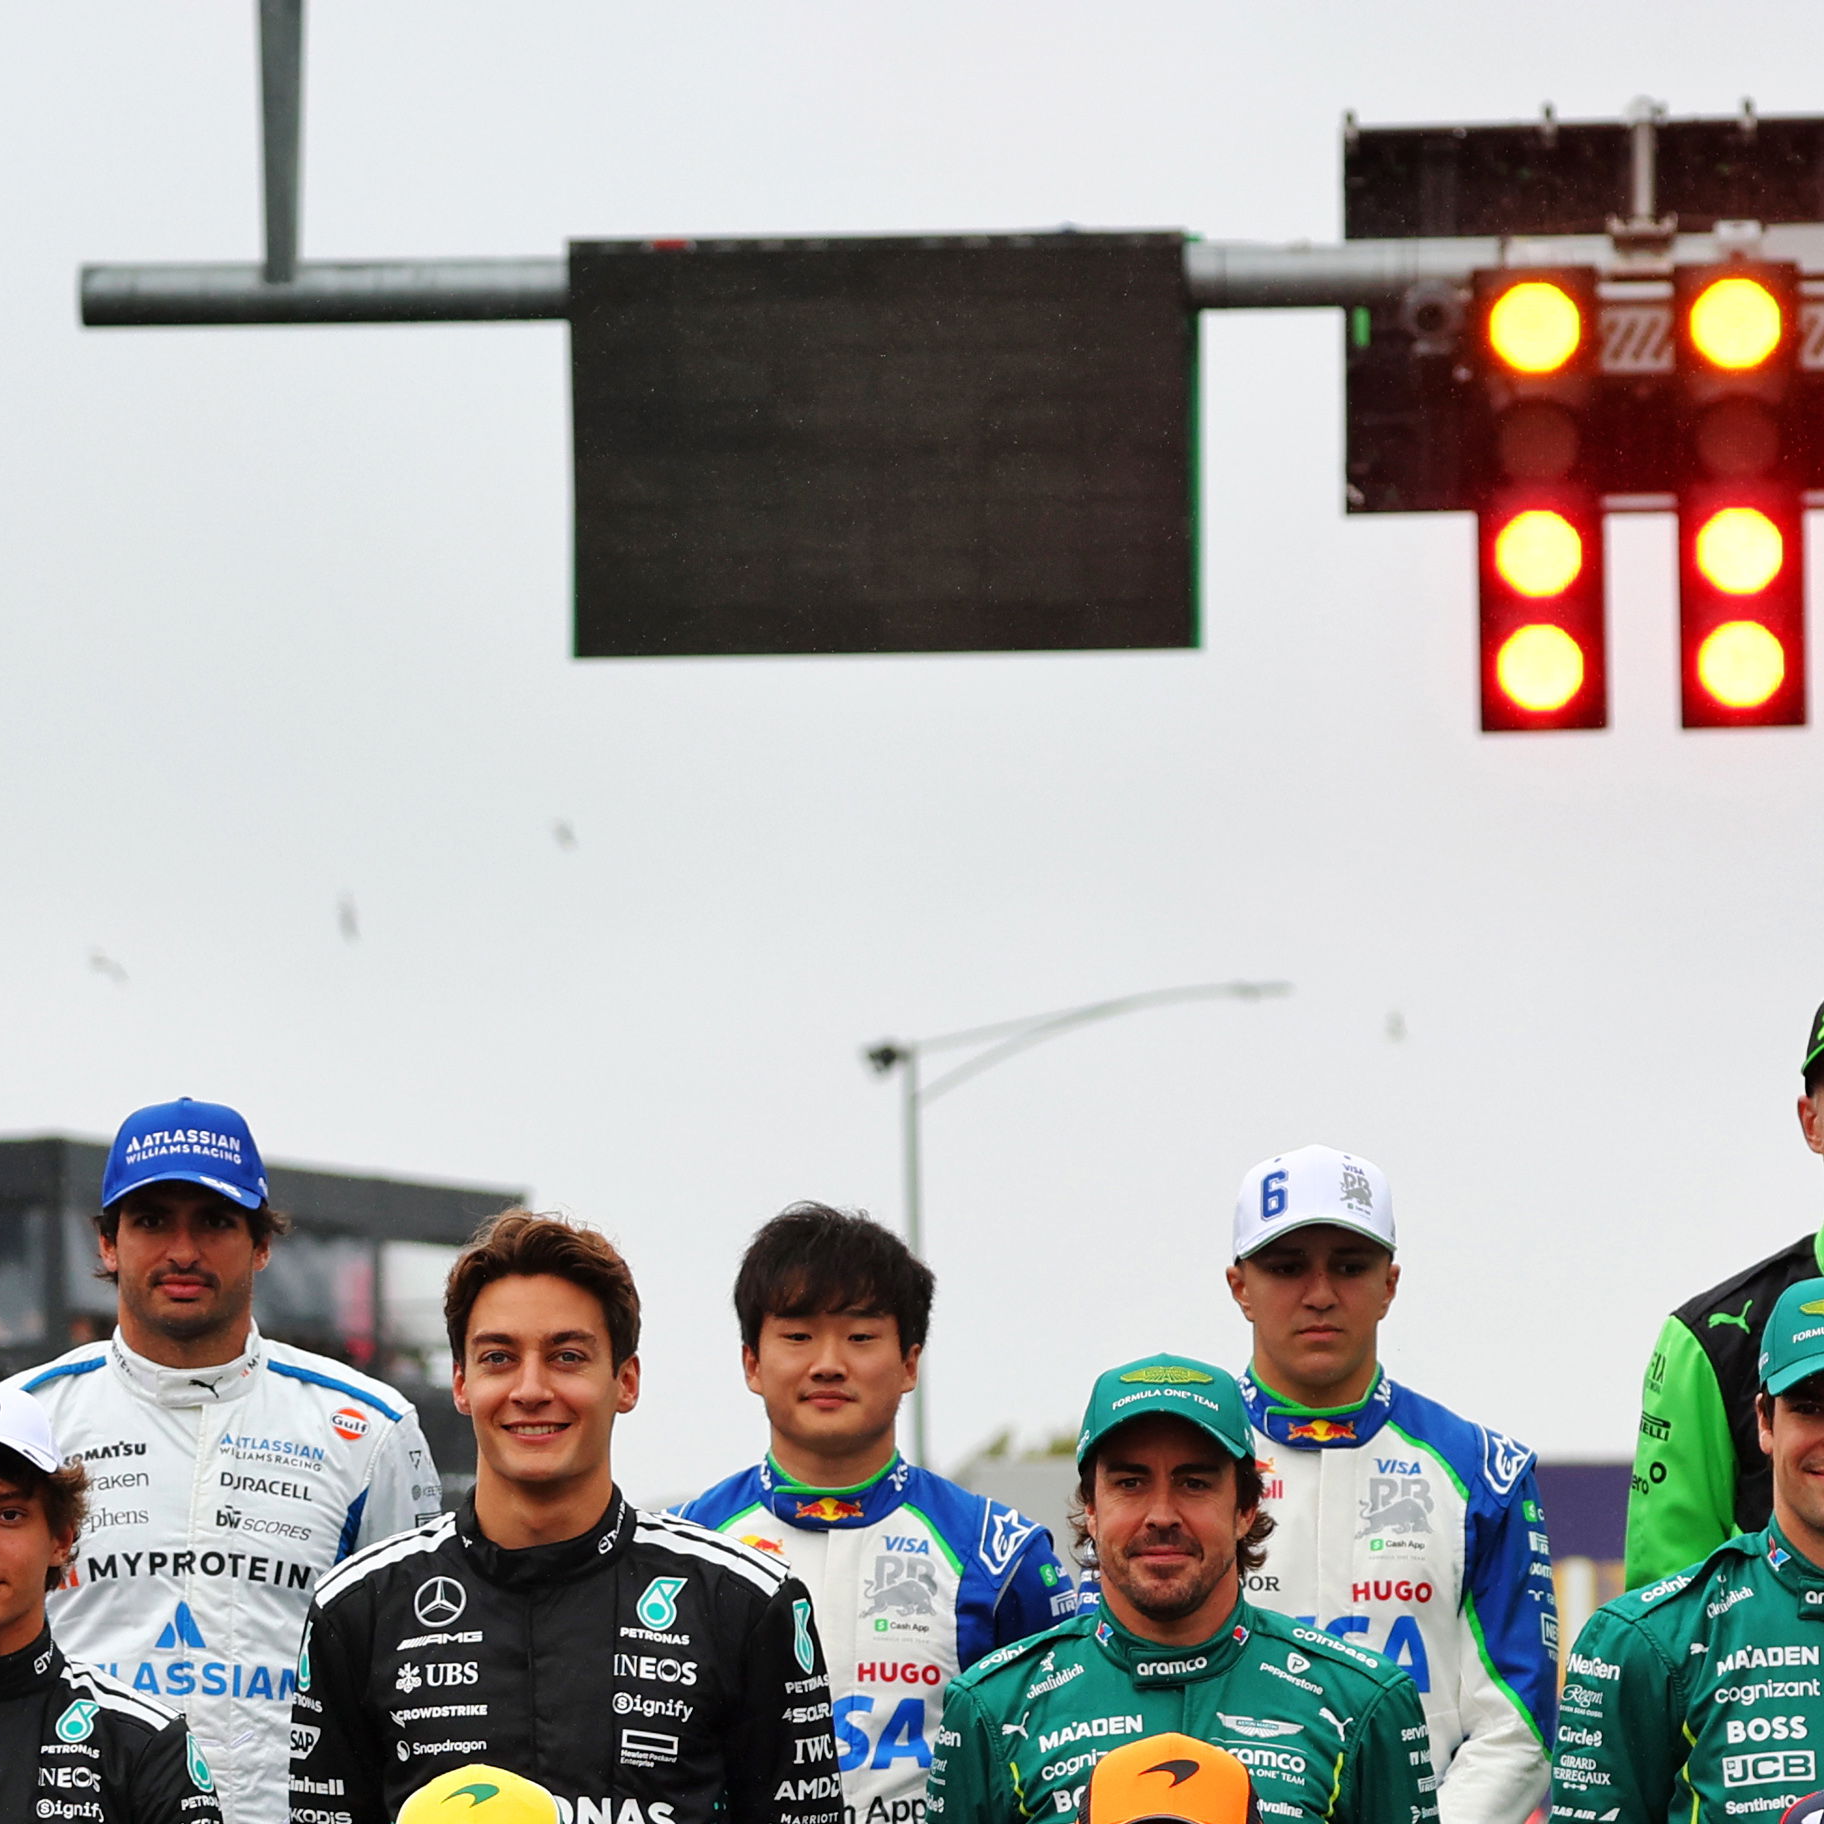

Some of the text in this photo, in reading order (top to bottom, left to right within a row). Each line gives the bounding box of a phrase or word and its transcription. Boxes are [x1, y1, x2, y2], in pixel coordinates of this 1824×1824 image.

[142, 1129, 241, 1152] ATLASSIAN
[126, 1144, 242, 1165] WILLIAMS RACING
[1260, 1168, 1289, 1221] 6
[1112, 1390, 1219, 1412] FORMULA TEAM
[1374, 1458, 1422, 1475] VISA
[882, 1535, 929, 1555] VISA
[88, 1549, 312, 1590] MYPROTEIN
[1352, 1581, 1432, 1602] HUGO
[620, 1626, 690, 1645] PETRONAS
[1292, 1627, 1378, 1669] coinbase
[426, 1662, 479, 1686] UBS
[613, 1654, 697, 1686] INEOS
[857, 1662, 941, 1685] HUGO
[1136, 1655, 1207, 1676] aramco
[1567, 1653, 1620, 1680] NexGen
[1259, 1661, 1324, 1695] pepperstone
[1715, 1677, 1821, 1705] cognizant
[397, 1705, 488, 1720] CROWDSTRIKE
[1727, 1716, 1808, 1744] BOSS
[40, 1744, 100, 1759] PETRONAS
[413, 1737, 487, 1755] Snapdragon
[794, 1734, 833, 1764] IWC
[1560, 1755, 1596, 1770] GIRARD
[1728, 1755, 1811, 1782] JCB
[38, 1767, 101, 1793] INEOS
[1281, 1773, 1305, 1786] TEAM
[781, 1812, 839, 1824] MARRIOTT
